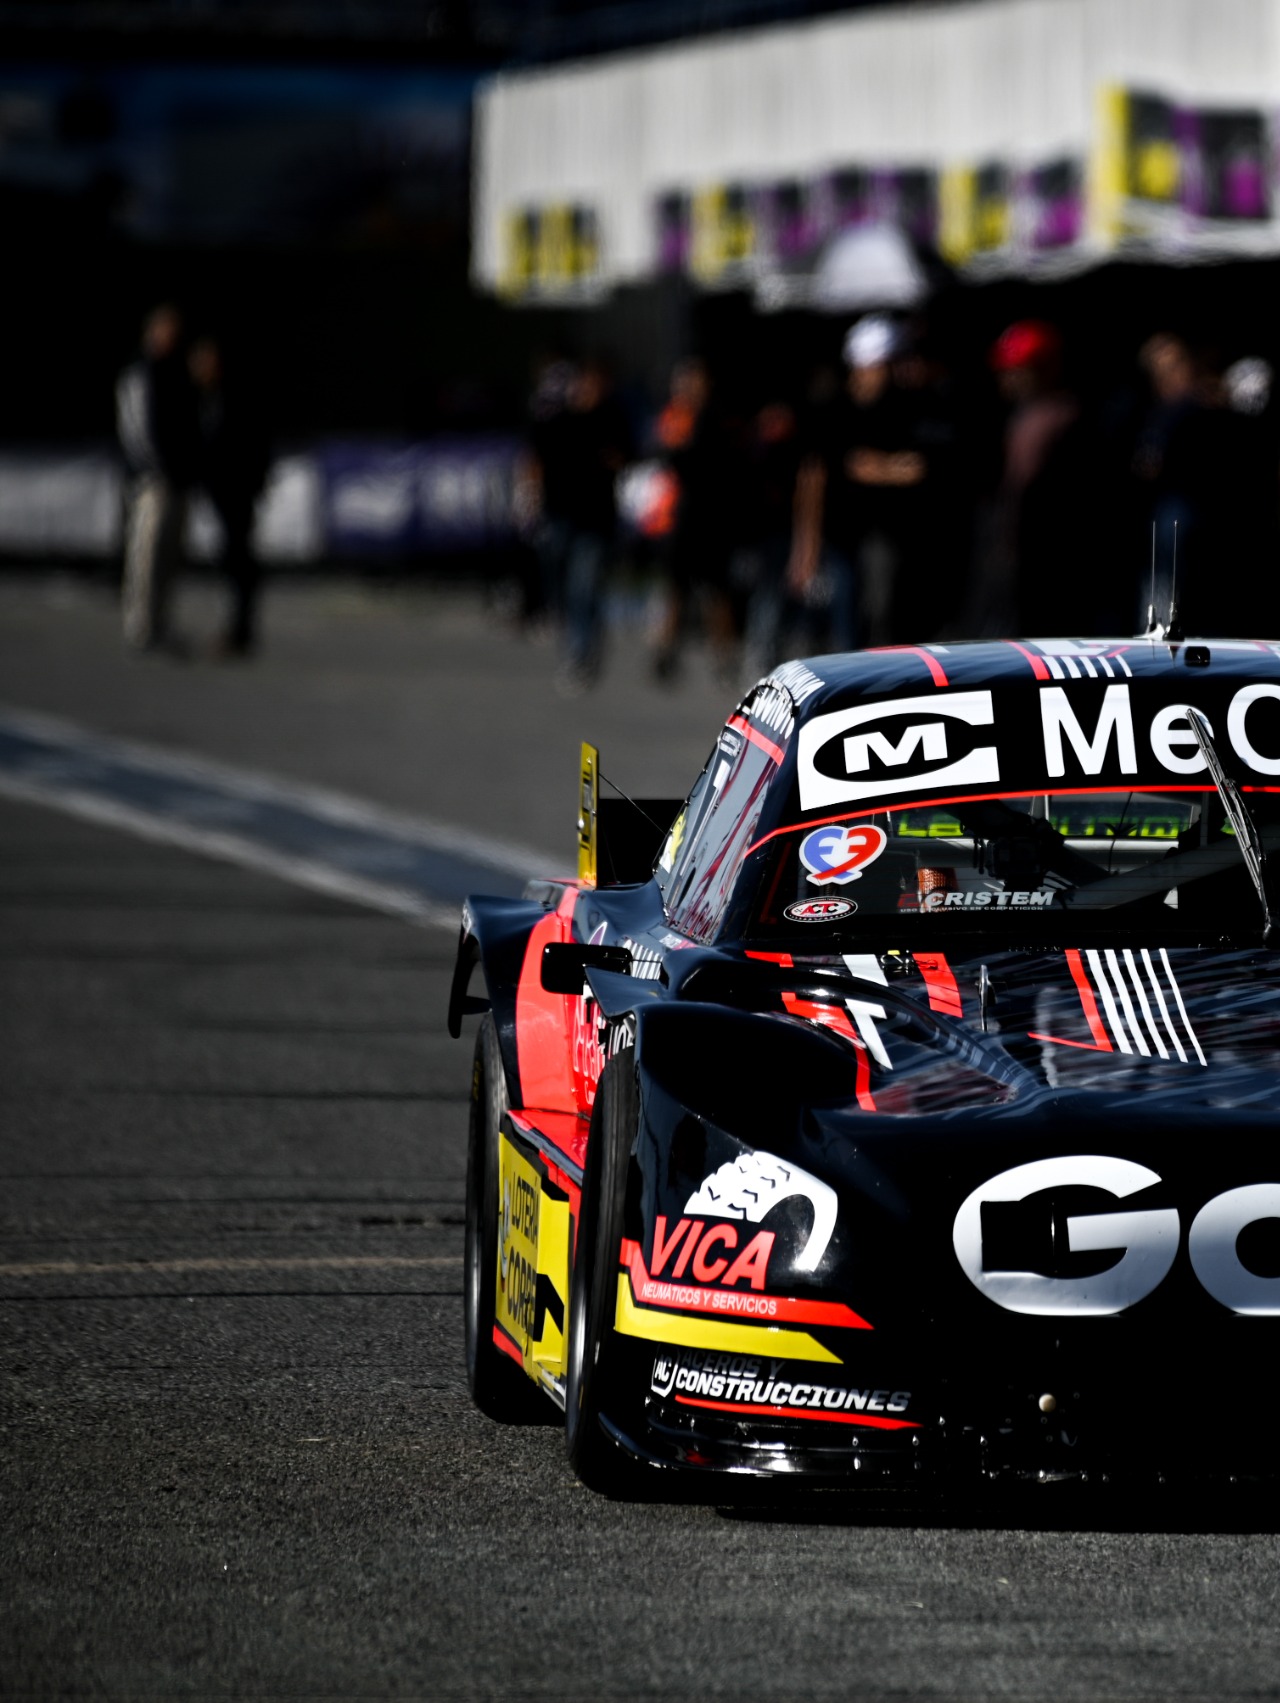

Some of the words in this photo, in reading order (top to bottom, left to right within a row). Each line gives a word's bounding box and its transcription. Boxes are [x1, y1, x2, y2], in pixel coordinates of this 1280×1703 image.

[925, 891, 1057, 907] CRISTEM
[650, 1215, 775, 1290] VICA
[641, 1283, 700, 1305] NEUMÁTICOS
[703, 1291, 713, 1306] Y
[712, 1293, 777, 1316] SERVICIOS
[654, 1355, 672, 1382] AC
[681, 1351, 762, 1378] ACEROS
[768, 1360, 786, 1379] Y
[675, 1366, 912, 1412] CONSTRUCCIONES
